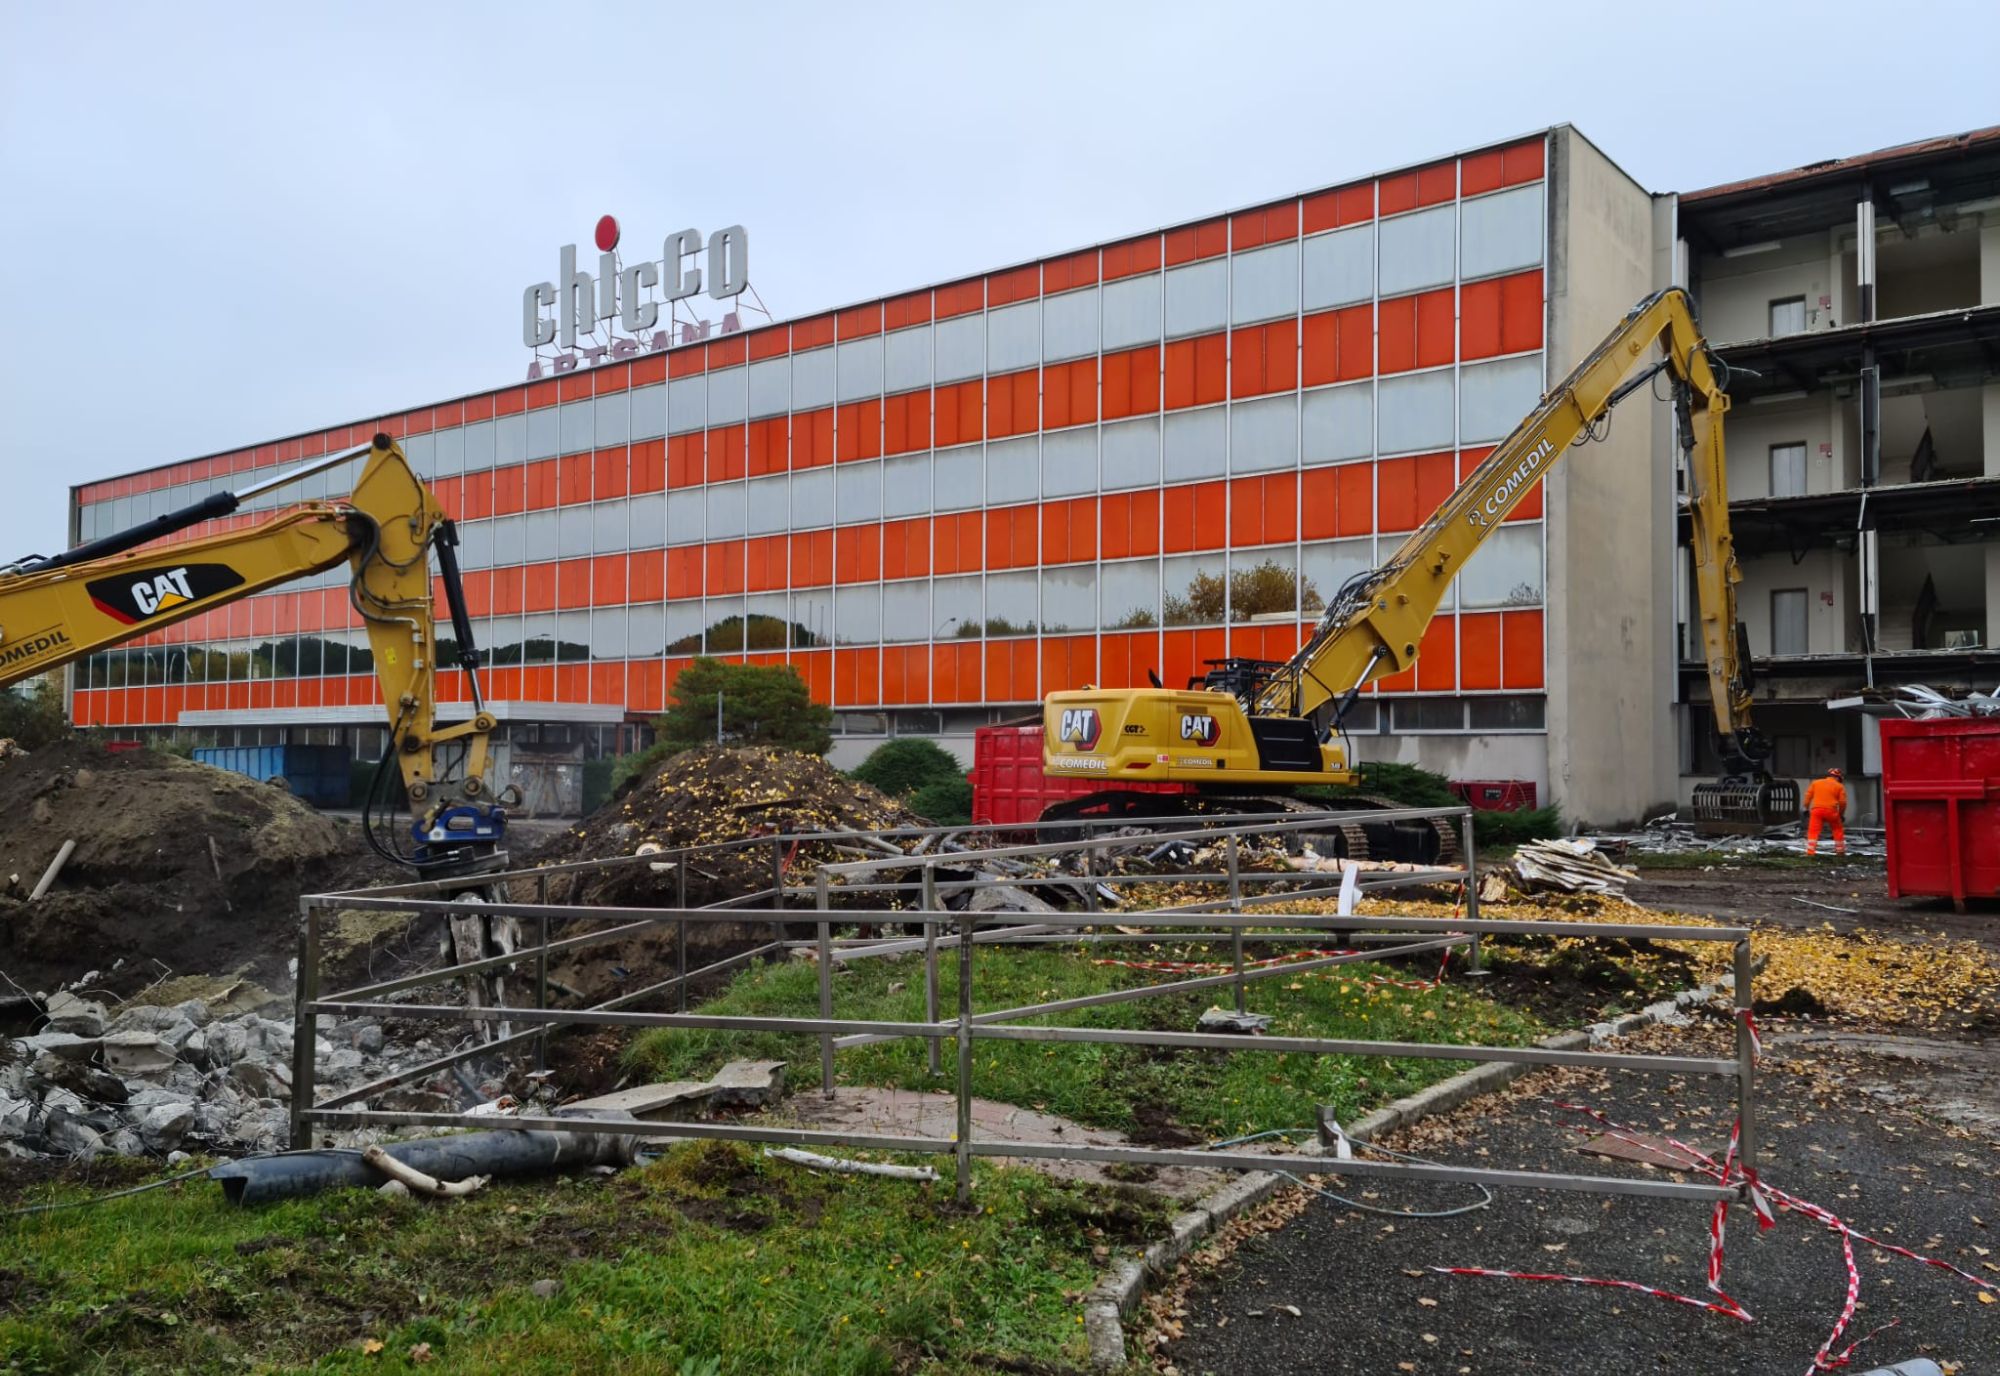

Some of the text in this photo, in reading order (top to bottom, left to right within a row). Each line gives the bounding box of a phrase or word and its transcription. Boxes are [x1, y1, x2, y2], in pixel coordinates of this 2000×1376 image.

[523, 215, 748, 348] chicco
[1486, 439, 1554, 514] COMEDIL
[131, 567, 194, 615] CAT
[1061, 710, 1093, 742] CAT
[1181, 715, 1211, 739] CAT
[1060, 759, 1107, 769] COMEDIL
